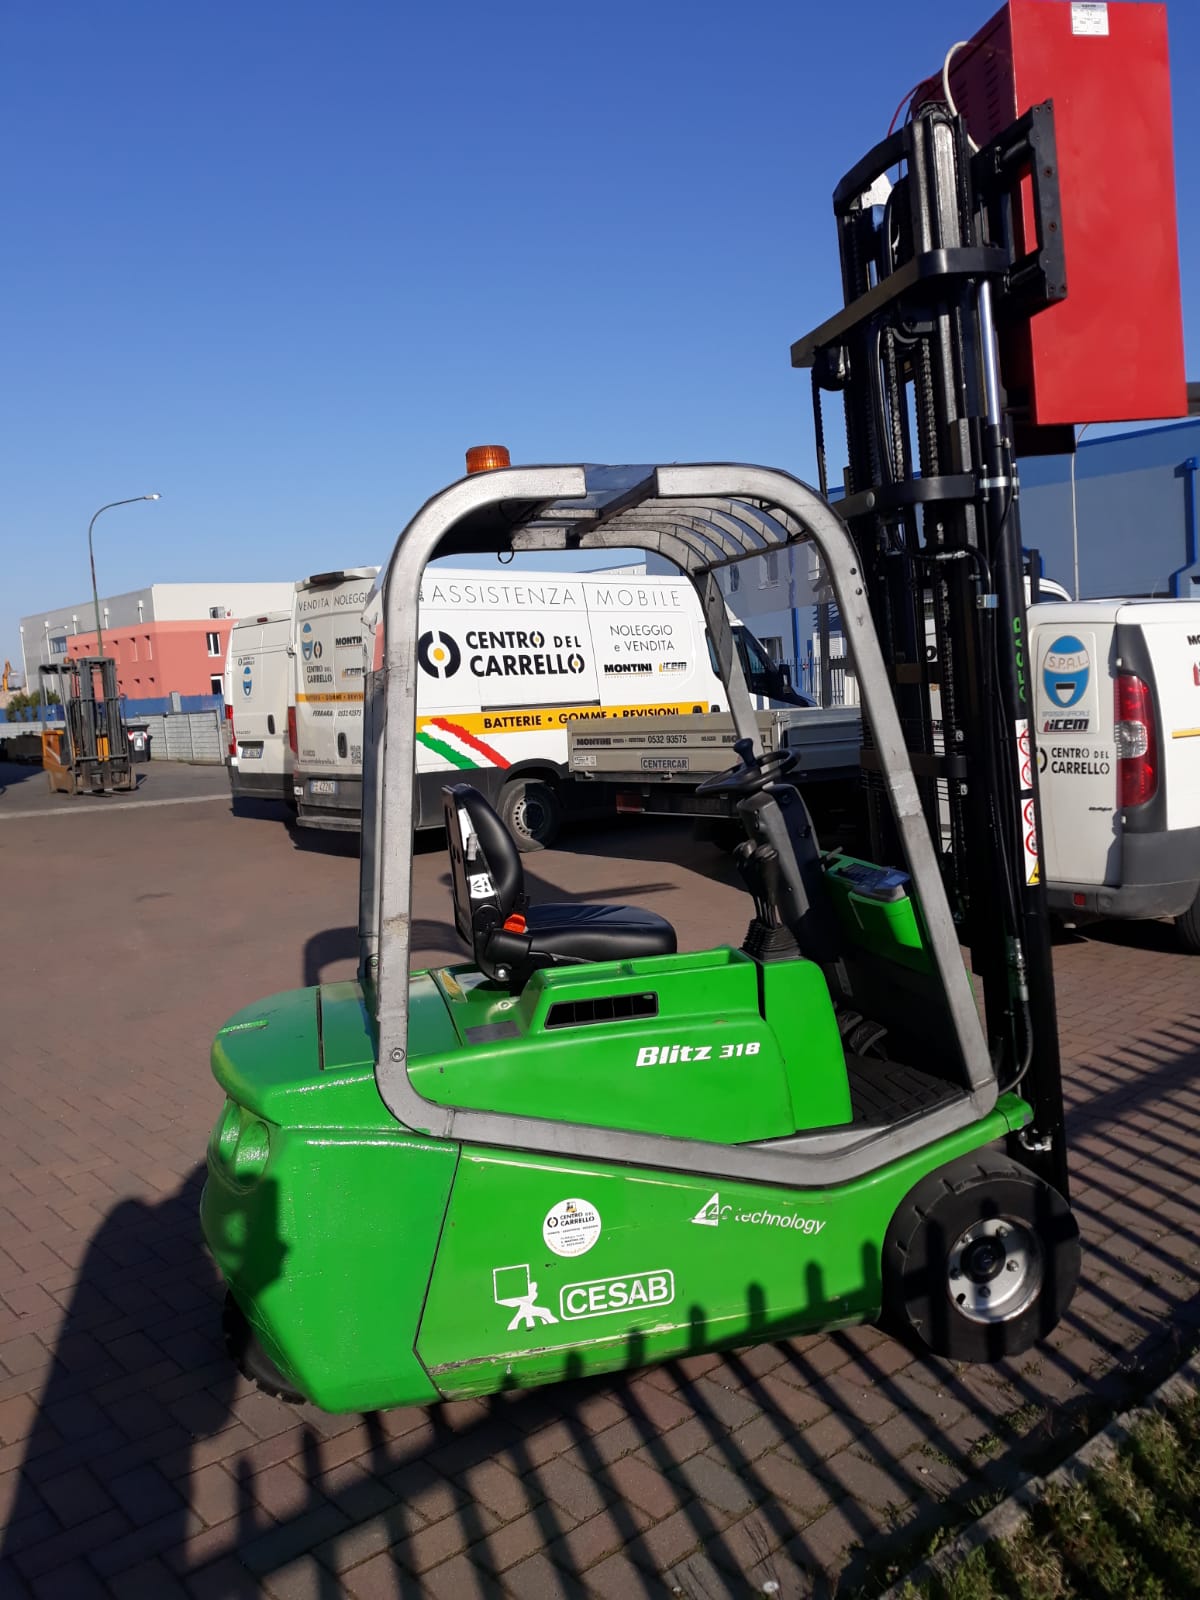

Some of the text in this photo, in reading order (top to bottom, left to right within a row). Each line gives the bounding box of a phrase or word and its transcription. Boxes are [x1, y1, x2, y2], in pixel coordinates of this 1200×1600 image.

[299, 592, 368, 611] VENDITA NOLEGGI
[432, 585, 576, 605] ASSISTENZA
[597, 589, 681, 607] MOBILE
[610, 624, 673, 636] NOLEGGIO
[336, 636, 362, 646] MONTIN
[466, 630, 581, 649] CENTRO DEL
[614, 641, 675, 652] e VENDITA
[307, 665, 323, 673] CENTRO
[470, 653, 585, 677] CARRELLO
[604, 663, 652, 673] MONTINI
[307, 674, 332, 683] CARRELLO
[484, 707, 679, 729] BATTERIE GOMME REVISIONI
[577, 738, 611, 746] MONTINI
[648, 735, 664, 744] 0532
[666, 735, 687, 744] 93575
[1051, 747, 1109, 759] CENTRO DEL
[643, 759, 687, 769] CENTERCAR
[1051, 761, 1110, 775] CARRELLO
[636, 1042, 760, 1067] Blitz 318
[560, 1212, 583, 1220] CENTRO
[560, 1216, 595, 1226] CARRELLO
[735, 1208, 826, 1235] technology
[566, 1276, 668, 1314] CESAB
